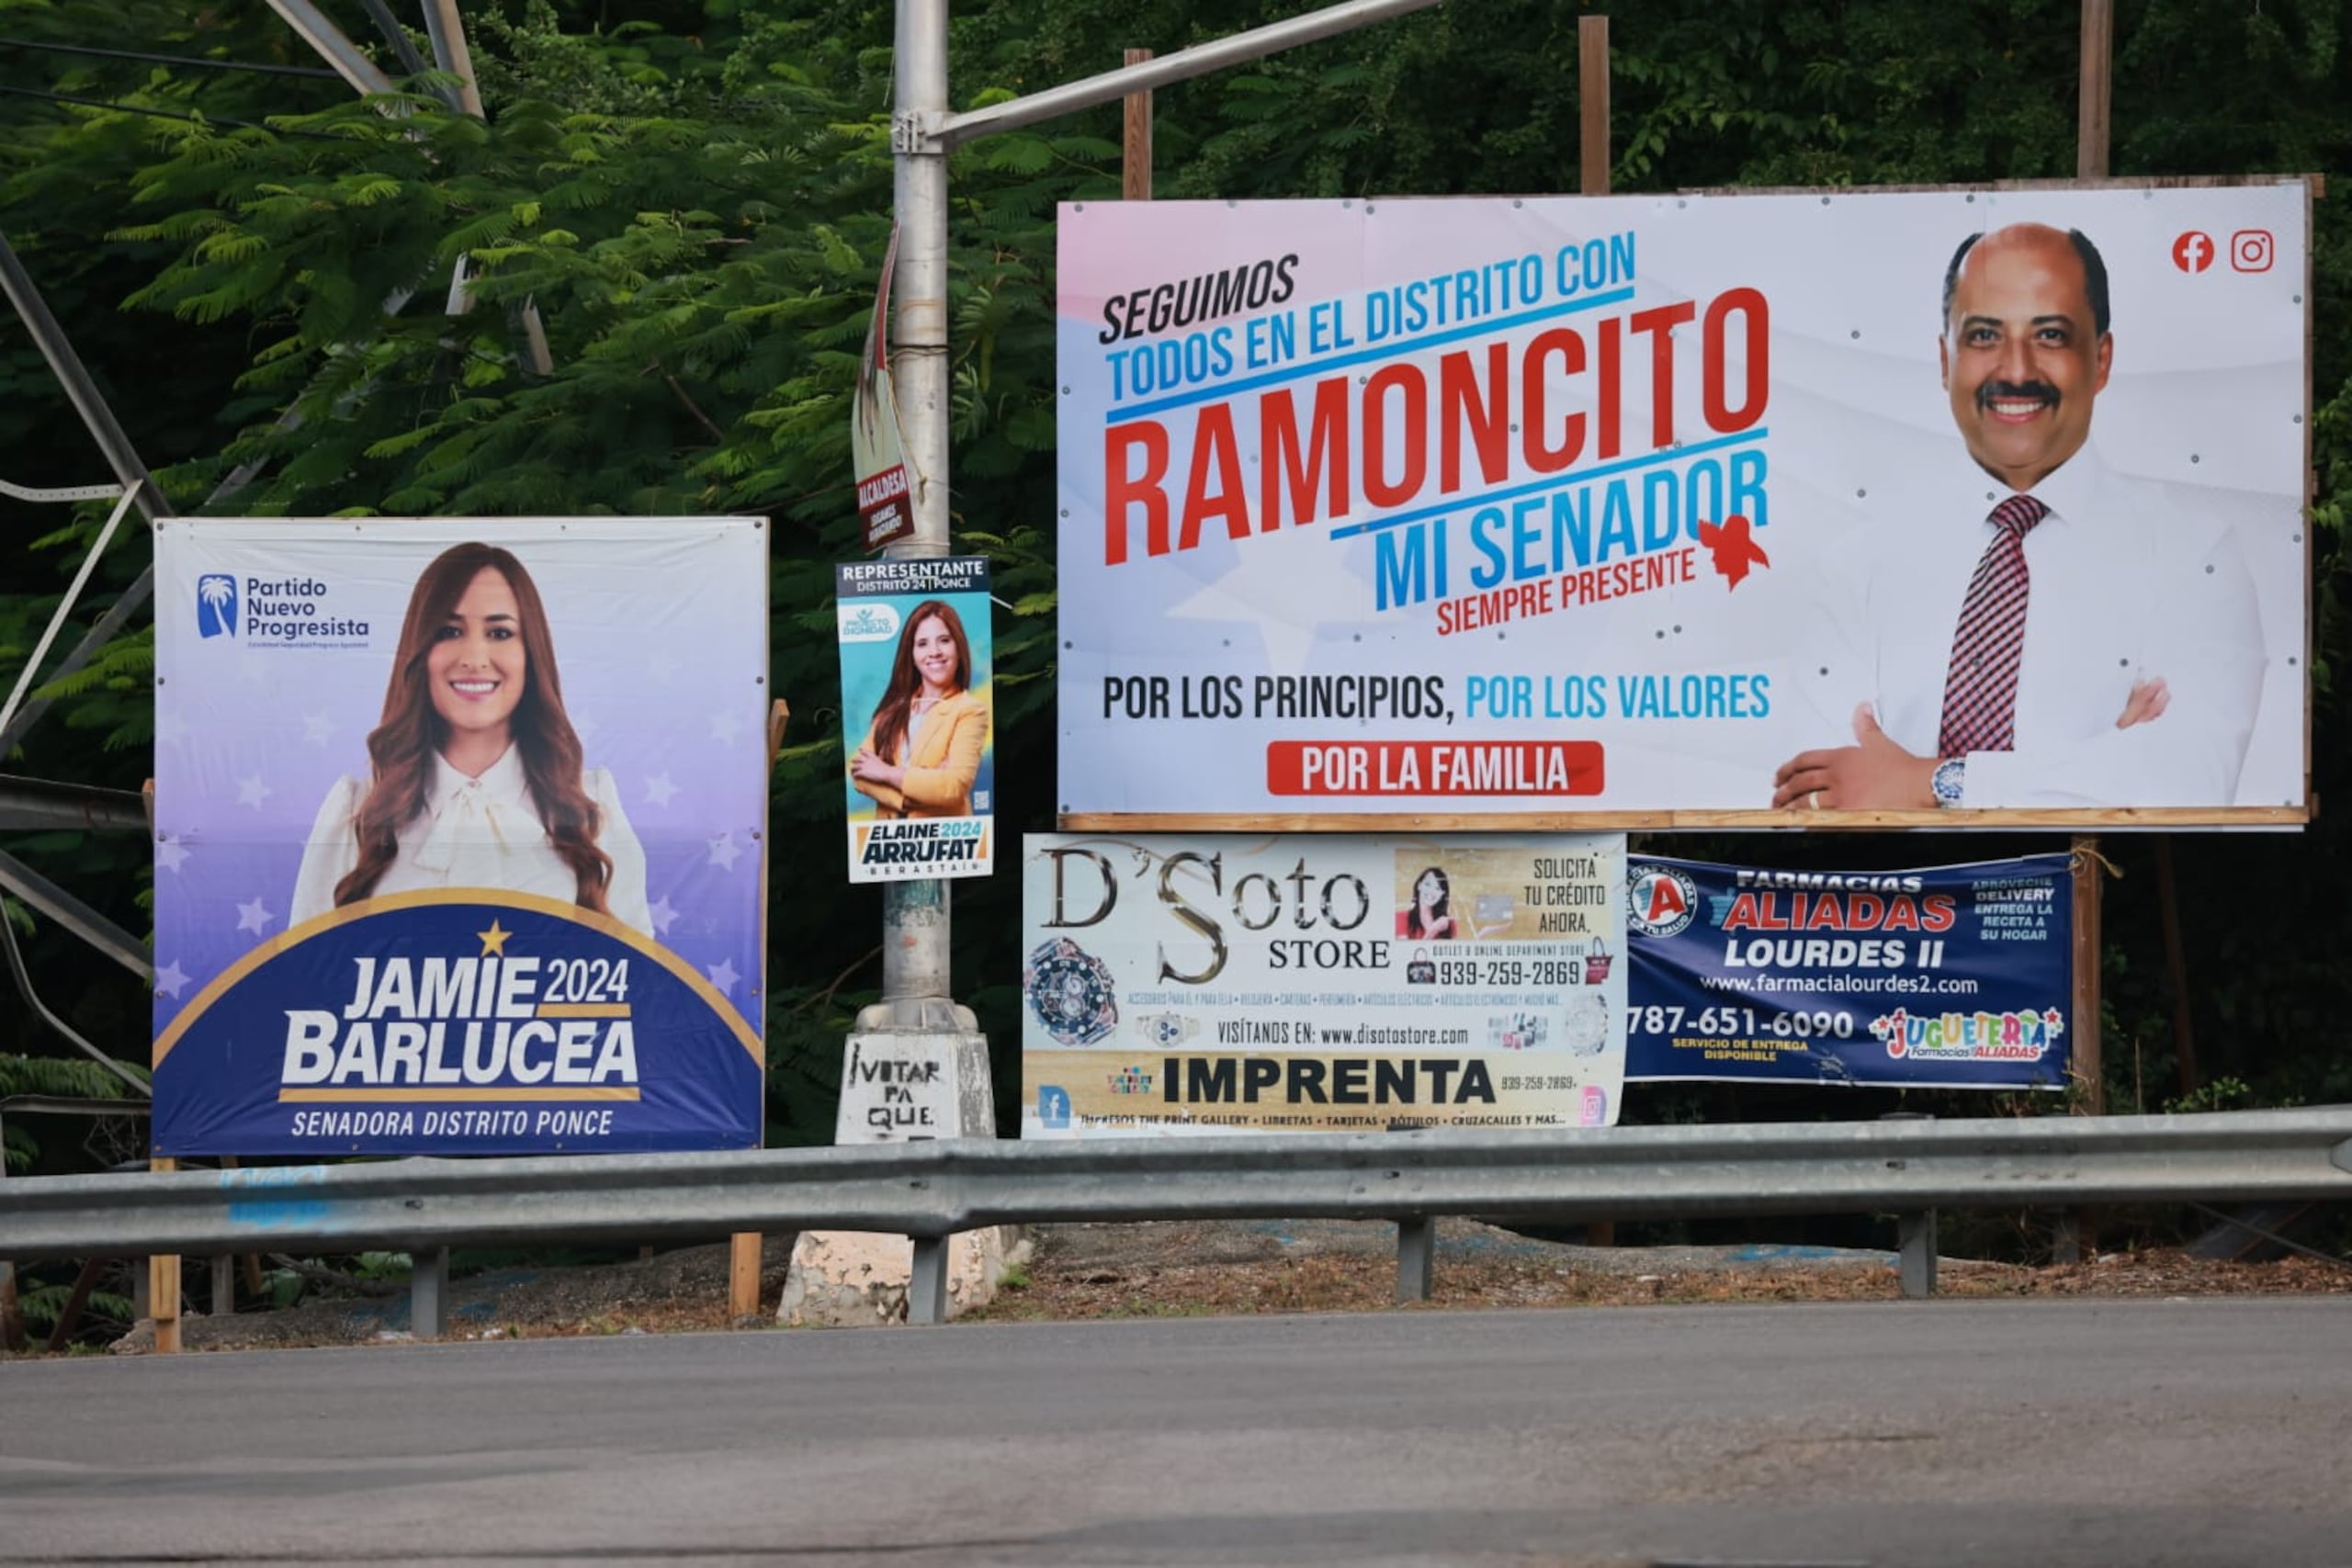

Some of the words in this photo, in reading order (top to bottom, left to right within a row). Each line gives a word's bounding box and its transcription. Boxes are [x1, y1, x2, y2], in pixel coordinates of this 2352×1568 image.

[1099, 254, 1299, 344] SEGUIMOS
[1105, 326, 1233, 401] TODOS
[1247, 310, 1295, 369] EN
[1309, 299, 1354, 355] EL
[1367, 254, 1543, 343] DISTRITO
[1556, 231, 1635, 298] CON
[1105, 287, 1770, 567] RAMONCITO
[859, 468, 907, 511] ALCALDESA
[1375, 518, 1448, 612] MI
[1470, 449, 1769, 590] SENADOR
[842, 561, 984, 581] REPRESENTANTE
[247, 578, 327, 596] Partido
[856, 578, 910, 592] DISTRITO
[934, 577, 971, 591] PONCE
[1437, 578, 1553, 637] SIEMPRE
[1562, 547, 1696, 609] PRESENTE
[247, 598, 315, 615] Nuevo
[247, 617, 369, 640] Progresista
[1103, 675, 1170, 719] POR
[1182, 675, 1243, 719] LOS
[1254, 675, 1455, 725] PRINCIPIOS,
[1465, 675, 1536, 719] POR
[1544, 675, 1607, 719] LOS
[1617, 675, 1770, 719] VALORES
[1302, 747, 1369, 791] POR
[1379, 747, 1422, 791] LA
[1431, 746, 1569, 791] FAMILIA
[870, 823, 940, 840] ELAINE
[941, 821, 982, 838] 2024
[862, 838, 979, 864] ARRUFAT
[1533, 857, 1597, 879] SOLICITA
[1524, 886, 1542, 906] TU
[1547, 883, 1606, 906] CRÉDITO
[1736, 871, 1924, 894] FARMACIAS
[1975, 887, 2055, 902] DELIVERY
[1722, 891, 1956, 933] ALIADAS
[1974, 904, 2033, 915] ENTREGA
[2037, 904, 2053, 915] LA
[1983, 916, 2033, 927] RECETA
[2035, 916, 2045, 927] A
[1980, 930, 1998, 941] SU
[2001, 930, 2047, 941] HOGAR
[1269, 940, 1390, 969] STORE
[1561, 945, 1585, 956] STORE
[1724, 939, 1905, 969] LOURDES
[1917, 940, 1945, 969] II
[1441, 961, 1579, 986] 939-259-2869
[1700, 973, 1978, 994] www.farmacialourdes2.com
[344, 956, 540, 1020] JAMIE
[543, 958, 628, 1002] 2024
[1218, 1018, 1289, 1043] VISÍTANOS
[1296, 1022, 1316, 1044] EN:
[1321, 1022, 1469, 1045] www.disotostore.com
[1627, 1005, 1854, 1040] 787-651-6090
[281, 1010, 639, 1085] BARLUCEA
[1672, 1037, 1729, 1049] SERVICIO
[1733, 1038, 1748, 1049] DE
[1751, 1038, 1808, 1052] ENTREGA
[1704, 1050, 1777, 1062] DISPONIBLE
[1912, 1045, 1970, 1057] Farmacias
[1975, 1045, 2040, 1058] ALIADAS
[1164, 1058, 1497, 1104] IMPRENTA
[291, 1111, 413, 1137] SENADORA
[423, 1110, 527, 1136] DISTRITO
[536, 1109, 613, 1136] PONCE
[1139, 1114, 1159, 1125] THE
[1164, 1114, 1196, 1125] PRINT
[1201, 1114, 1250, 1125] GALLERY
[1262, 1115, 1313, 1126] LIBRETAS
[1327, 1115, 1377, 1126] TARJETAS
[1452, 1114, 1521, 1126] CRUZACALLES
[1526, 1115, 1532, 1125] Y
